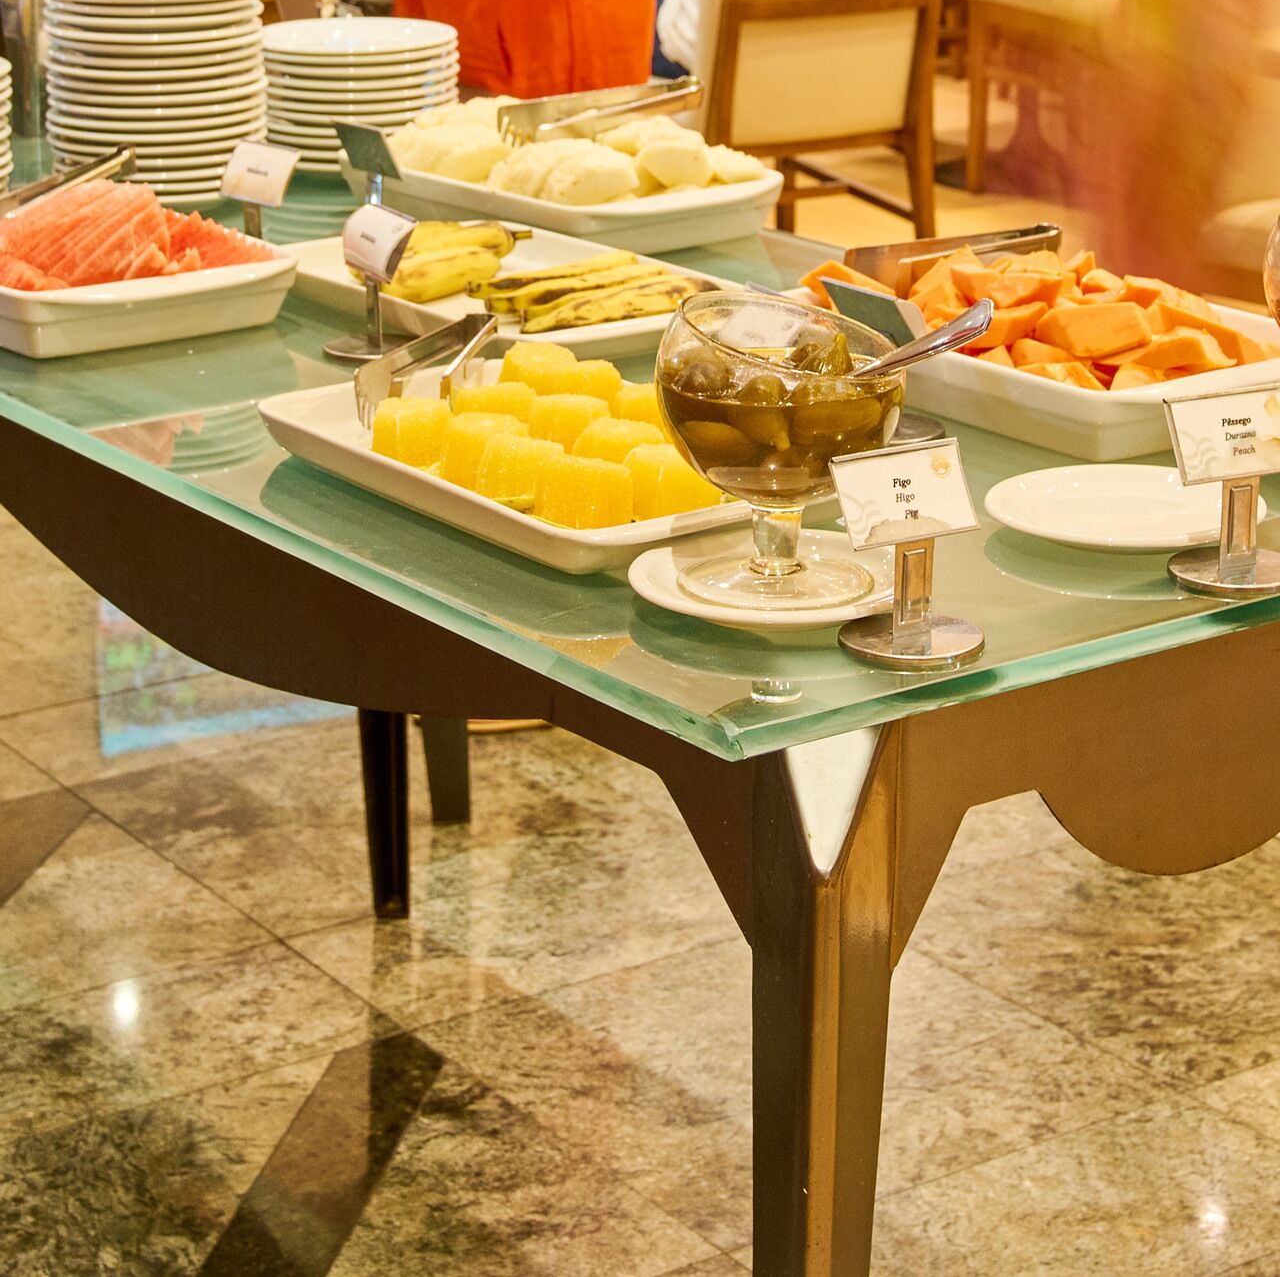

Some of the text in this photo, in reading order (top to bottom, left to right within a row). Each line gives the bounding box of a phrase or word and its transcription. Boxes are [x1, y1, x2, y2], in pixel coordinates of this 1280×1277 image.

[1221, 416, 1252, 428] Pêssego
[1224, 430, 1257, 442] Durazno
[1232, 444, 1257, 457] Peach
[892, 478, 912, 489] Figo
[895, 492, 915, 503] Higo
